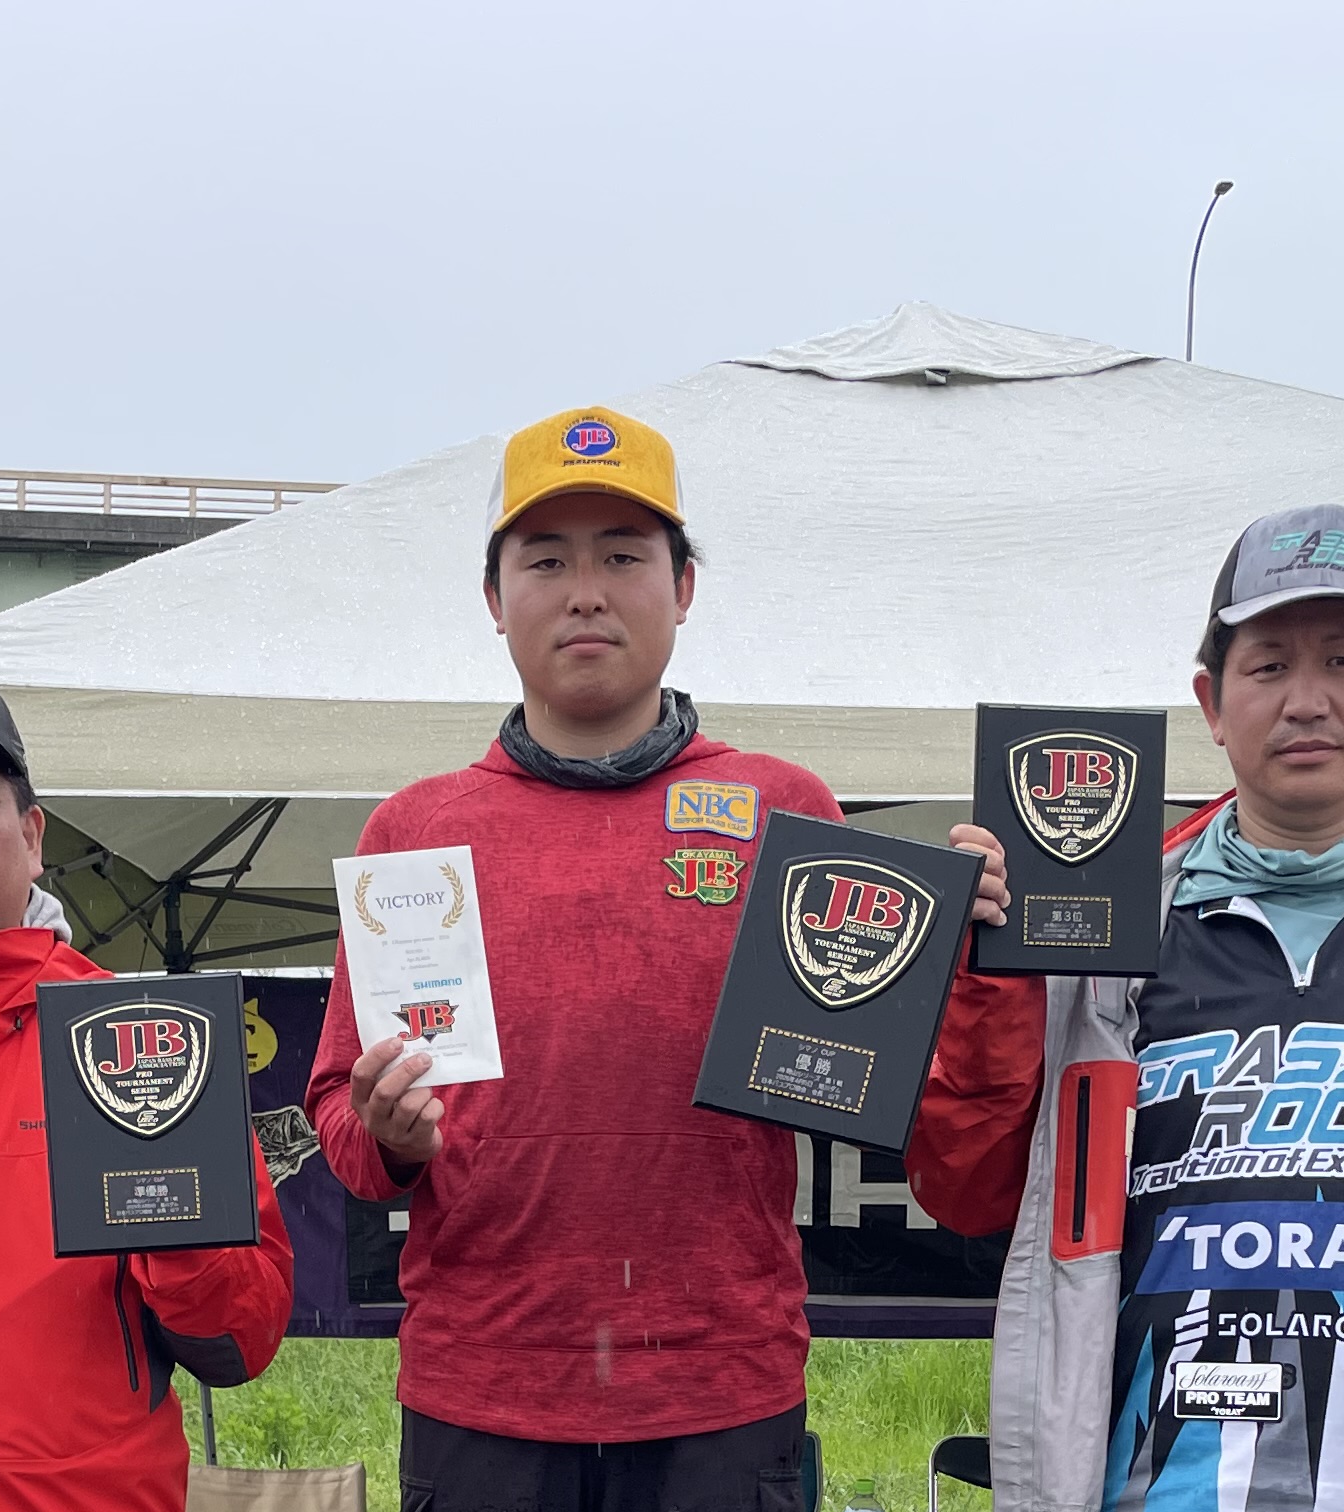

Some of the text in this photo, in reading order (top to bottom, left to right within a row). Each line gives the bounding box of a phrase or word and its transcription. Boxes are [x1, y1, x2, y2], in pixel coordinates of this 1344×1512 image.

[571, 428, 611, 451] JB
[1031, 748, 1115, 800] JB
[675, 791, 749, 824] NBC
[681, 851, 731, 860] OKAYAMA
[667, 859, 739, 897] JB
[375, 891, 446, 910] VICTORY
[712, 889, 726, 900] 22
[803, 873, 906, 932] JB
[814, 938, 876, 959] TOURNAMENT
[838, 934, 856, 945] PRO
[827, 950, 858, 963] SERIES
[413, 977, 463, 990] SHIMANO
[397, 1004, 456, 1042] JB
[98, 1019, 187, 1075] JB
[795, 1053, 832, 1076] 優勝
[115, 1078, 175, 1088] TOURNAMENT
[136, 1071, 153, 1079] PRO
[130, 1087, 160, 1095] SERIES
[1261, 1149, 1303, 1174] of
[1185, 1391, 1271, 1406] PRO TEAM
